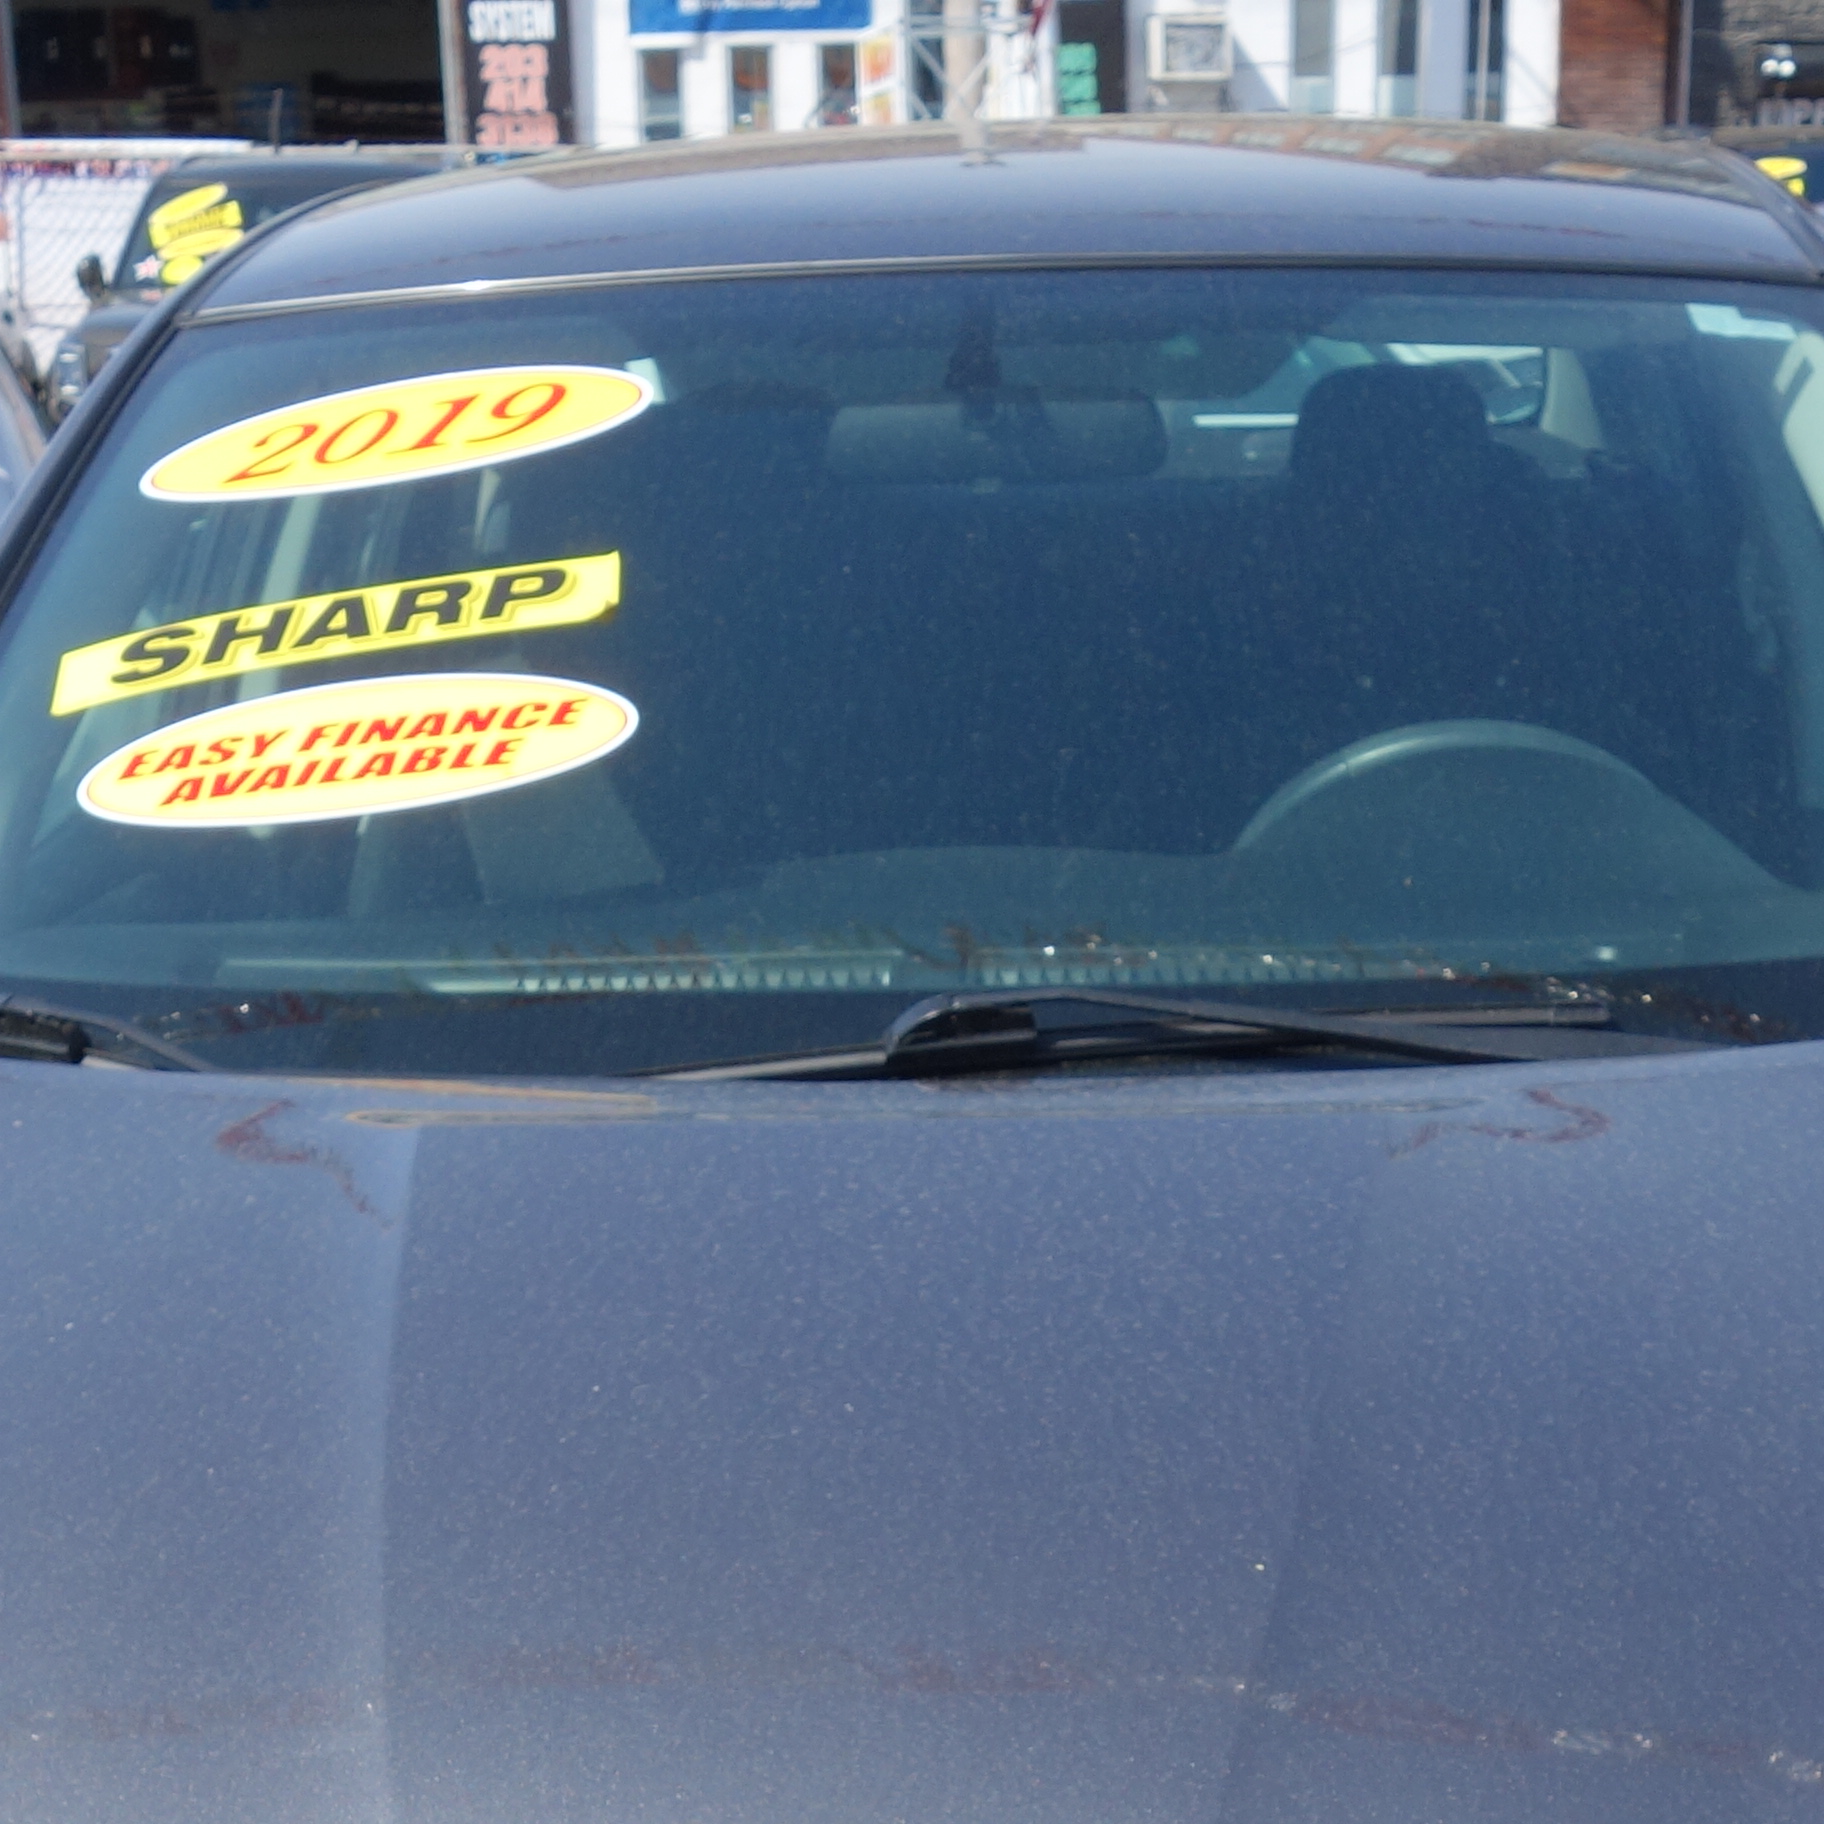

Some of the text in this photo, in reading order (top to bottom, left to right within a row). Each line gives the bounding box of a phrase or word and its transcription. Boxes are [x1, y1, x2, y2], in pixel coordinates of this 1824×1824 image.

[468, 0, 556, 43] SYSTEM
[222, 382, 567, 485] 2019
[110, 567, 574, 686] SHARP
[119, 699, 588, 781] EASY FINANCE
[159, 738, 524, 807] AVAILABLE
